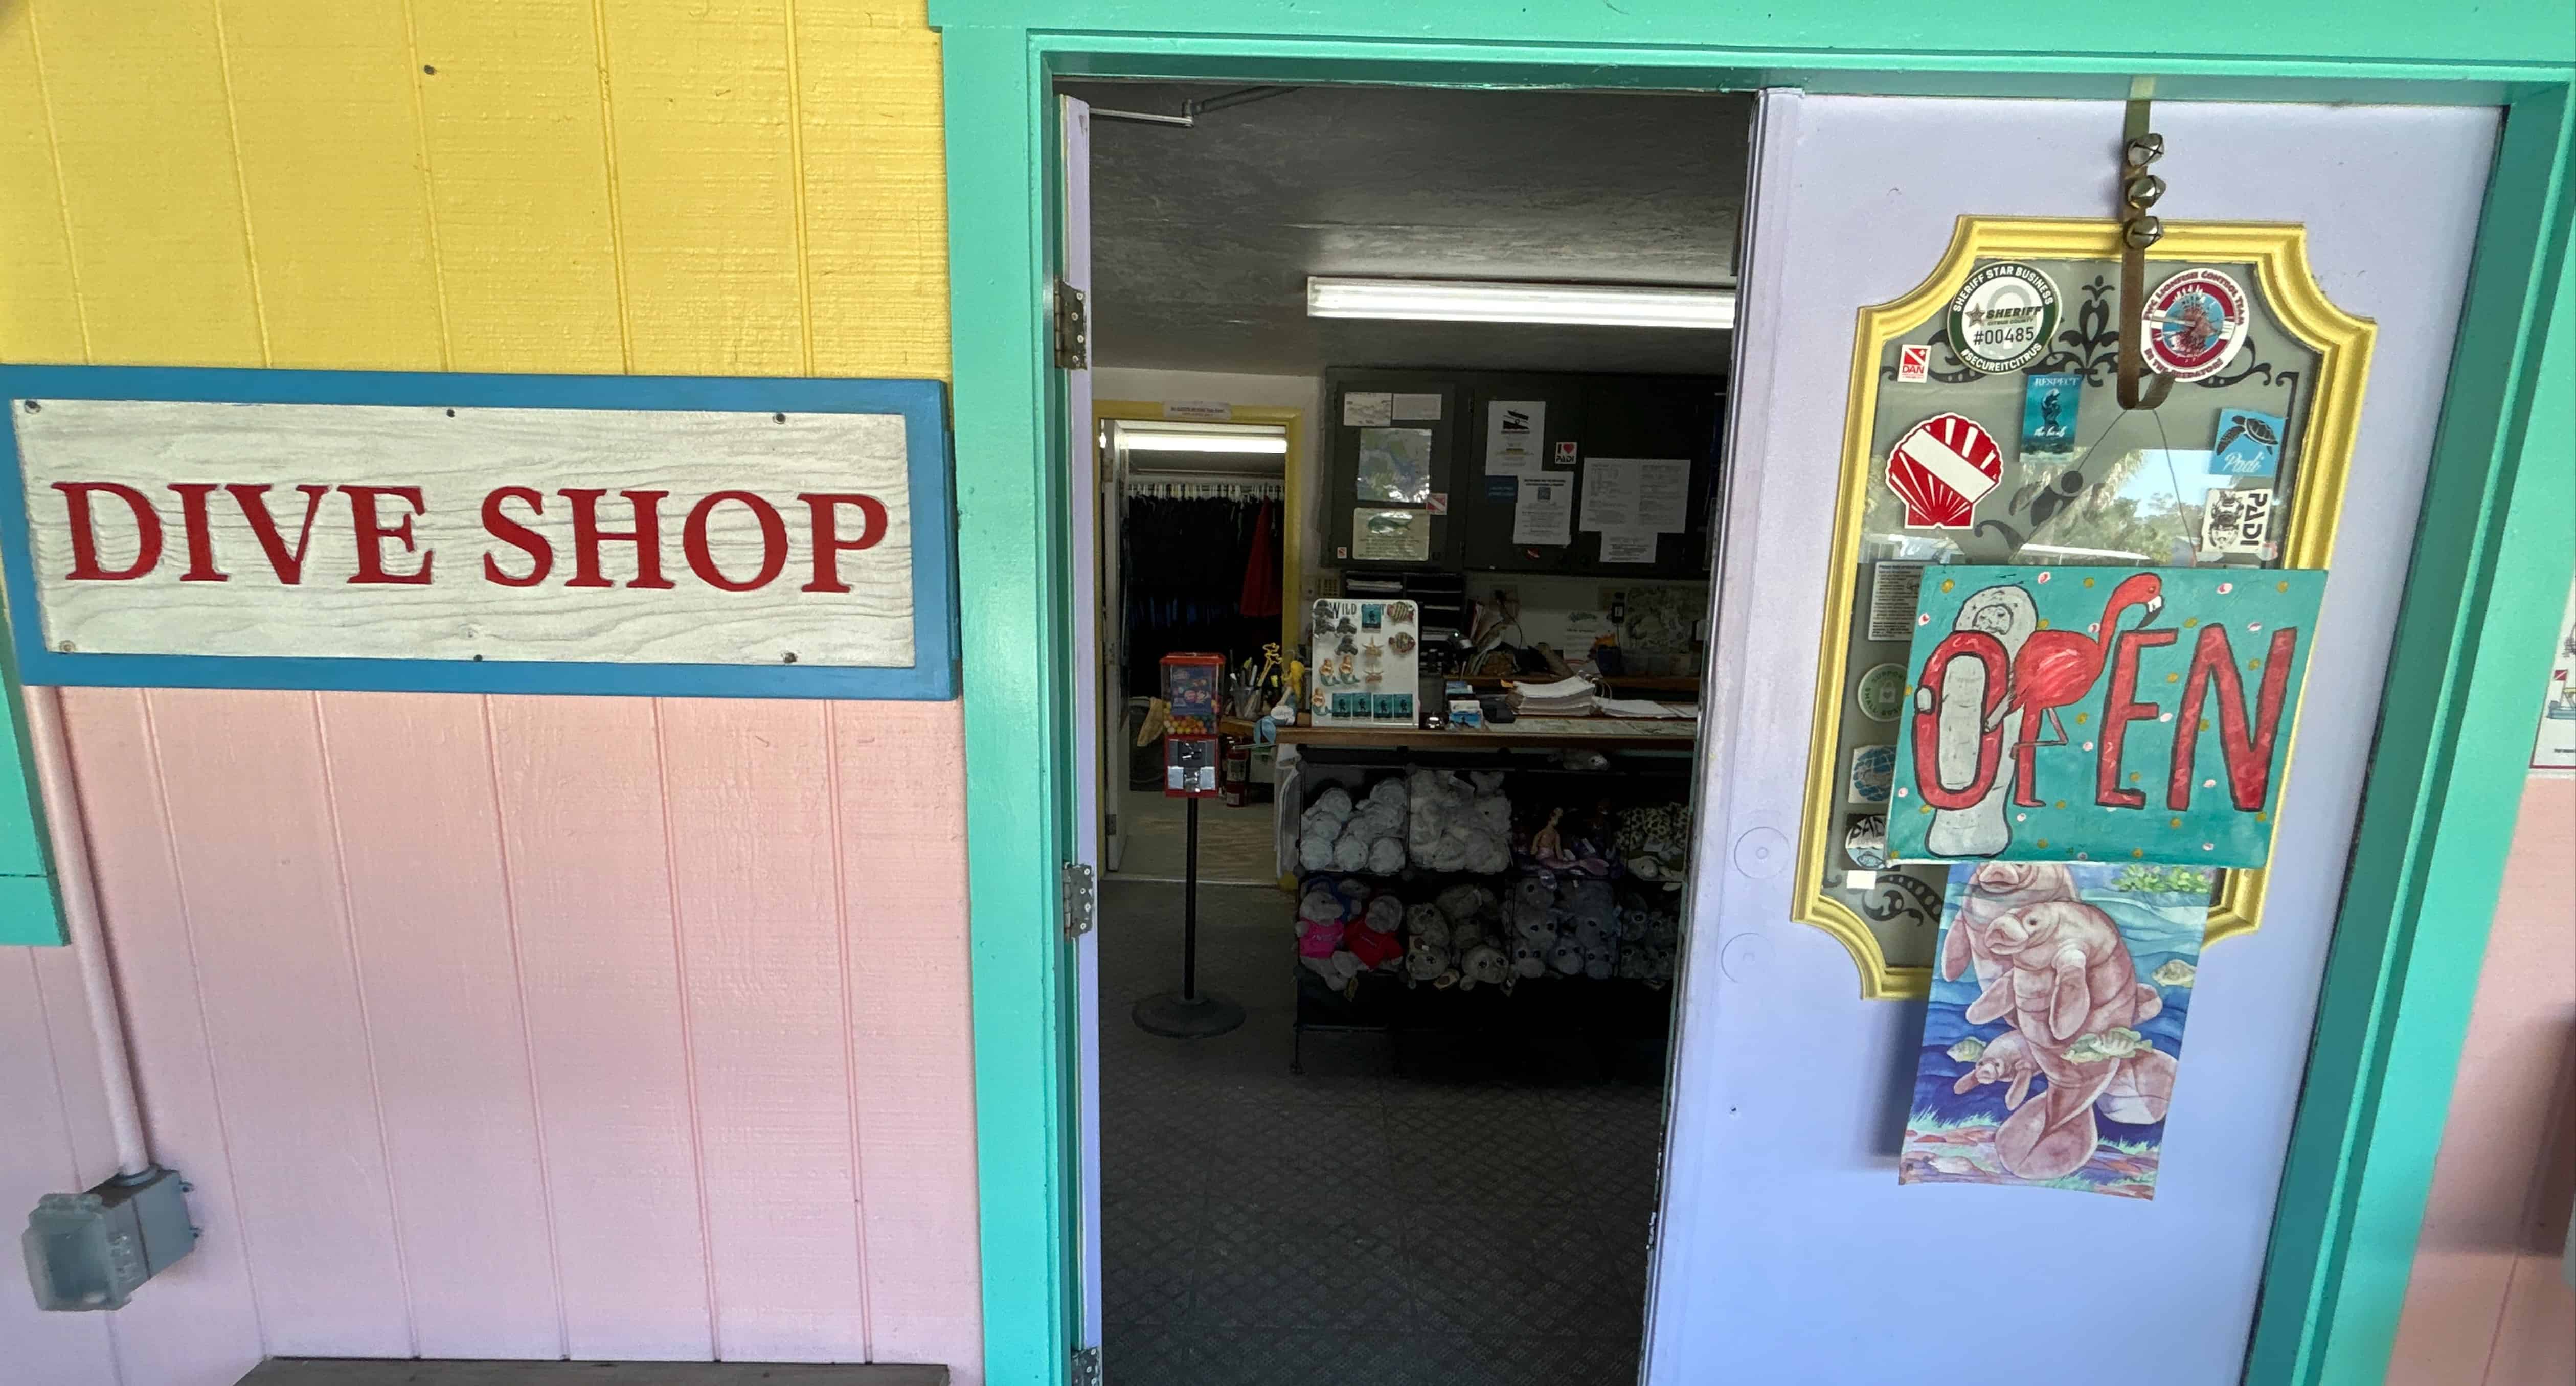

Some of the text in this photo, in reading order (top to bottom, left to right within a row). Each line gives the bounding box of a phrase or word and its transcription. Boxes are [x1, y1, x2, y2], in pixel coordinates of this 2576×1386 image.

[1953, 266, 2054, 312] SHERIFF STAR BUSINESS
[2201, 270, 2238, 297] CONTROL
[2235, 296, 2245, 326] TEAM
[1986, 307, 2043, 319] SHERIFF
[1974, 327, 2034, 345] #00485
[1902, 365, 1925, 374] DAN
[1961, 343, 2042, 371] #SECUREITCITRUS
[2222, 451, 2265, 473] Padi
[2240, 493, 2268, 546] PADI
[52, 482, 890, 595] DIVE SHOP
[1911, 622, 2297, 812] OPEN
